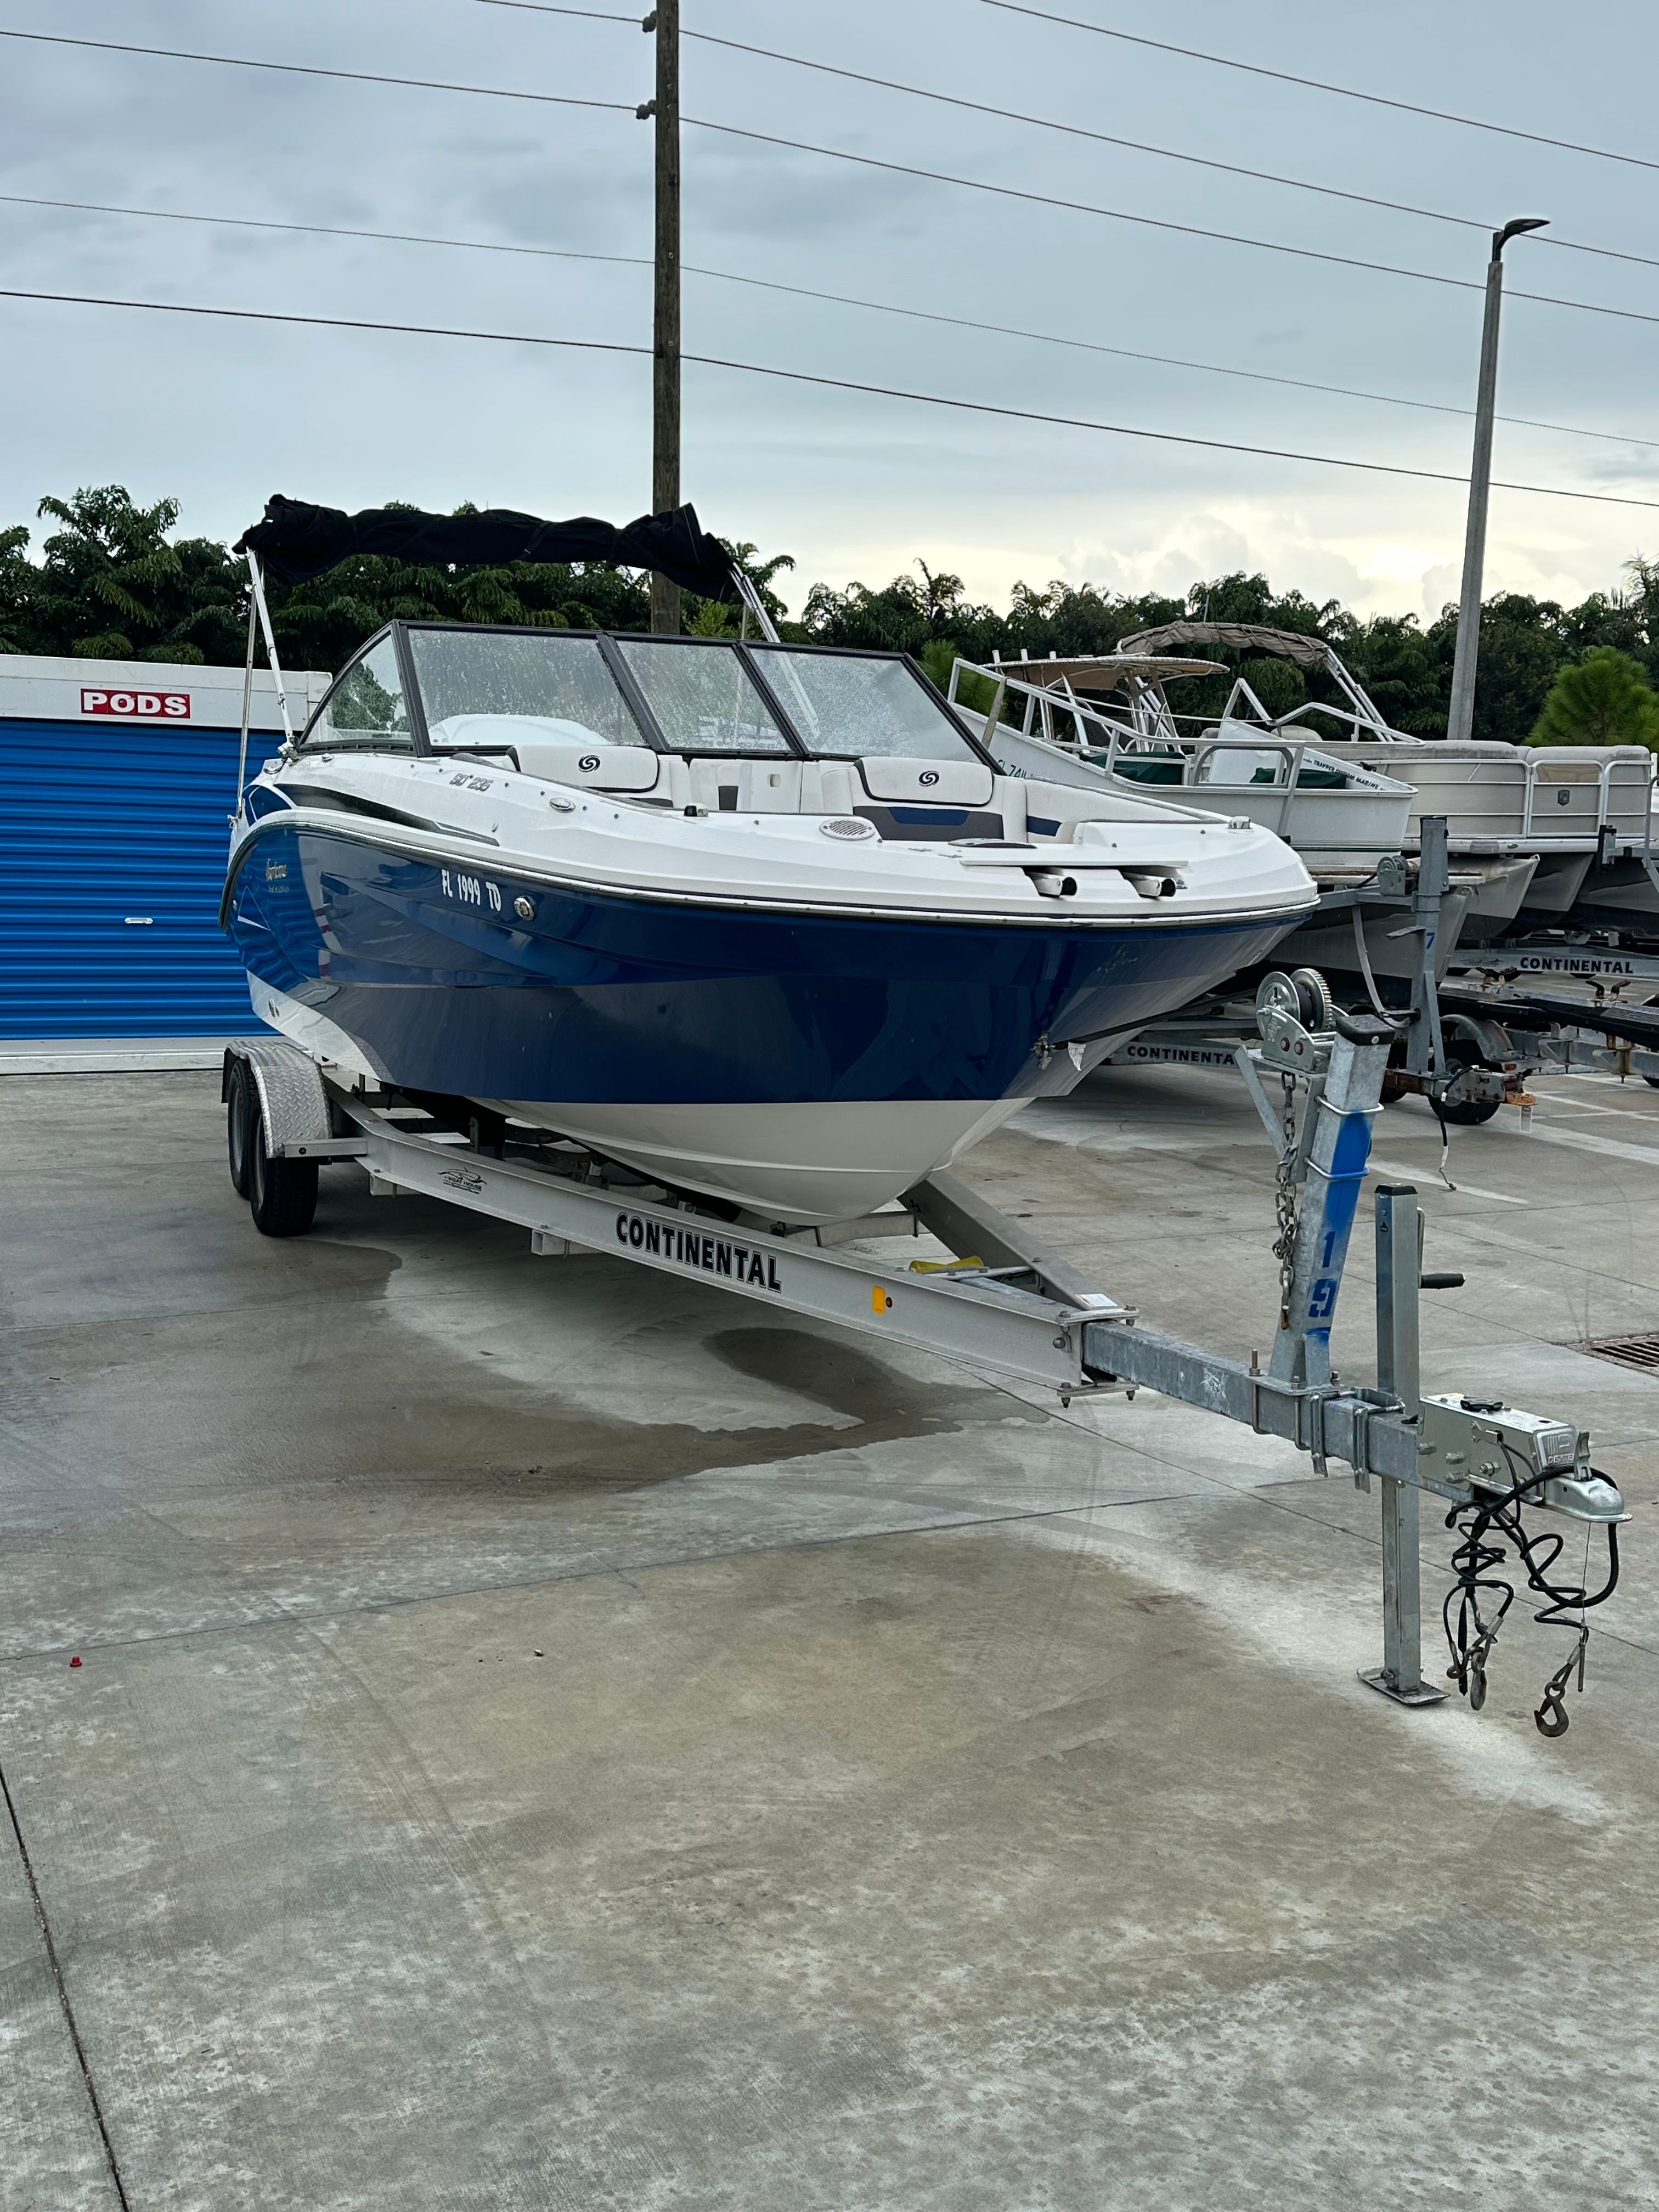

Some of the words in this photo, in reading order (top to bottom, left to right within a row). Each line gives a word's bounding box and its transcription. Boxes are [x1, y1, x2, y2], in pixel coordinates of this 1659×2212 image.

[83, 692, 187, 715] PODS
[467, 777, 494, 792] 235
[441, 868, 453, 898] FL
[457, 873, 481, 906] 1999
[485, 881, 501, 911] TD
[1426, 932, 1435, 949] 7
[1520, 956, 1634, 975] CONTINENTAL
[1127, 1046, 1239, 1066] CONTINENTA
[616, 1211, 782, 1294] CONTINENTAL
